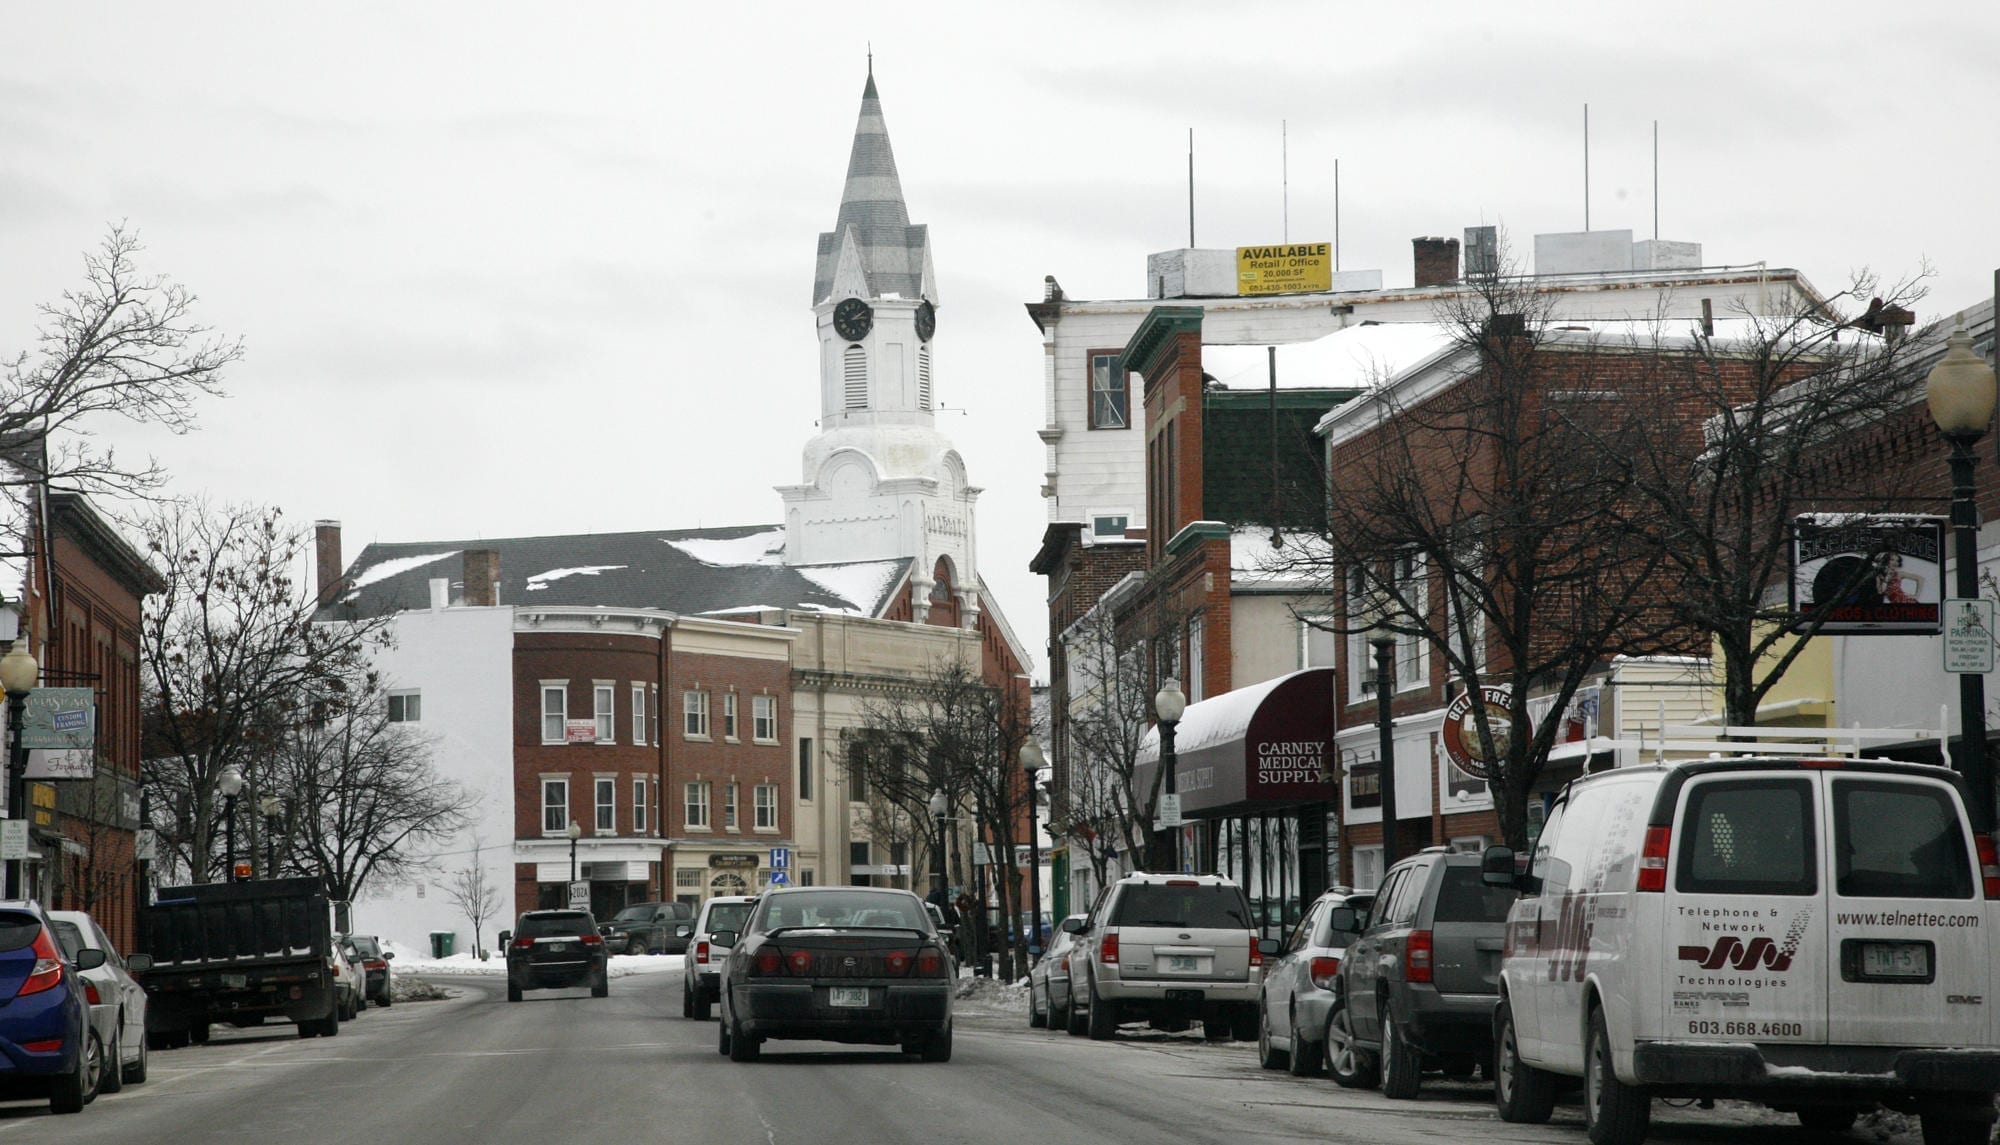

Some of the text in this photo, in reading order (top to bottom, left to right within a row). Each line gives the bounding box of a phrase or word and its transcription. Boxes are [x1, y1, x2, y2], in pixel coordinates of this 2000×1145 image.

[1242, 244, 1326, 259] AVAILABLE
[1250, 260, 1280, 269] Retail
[1289, 259, 1320, 267] Office
[1874, 606, 1937, 620] CLOTHING
[1961, 605, 1978, 614] TWO
[1951, 627, 1986, 638] PARKING
[1484, 690, 1513, 710] FRES
[57, 713, 82, 721] CUSTOM
[56, 721, 85, 729] FRAMING
[1258, 742, 1325, 755] CARNEY
[1258, 770, 1322, 784] SUPPLY
[773, 849, 785, 867] H
[573, 887, 588, 898] 202A
[1678, 907, 1778, 918] Telephone &
[1837, 910, 1979, 927] www.telnettec.com
[1702, 922, 1766, 932] Network
[1678, 976, 1787, 988] Technologies
[1946, 995, 1983, 1004] GMC
[1688, 1020, 1802, 1036] 603.668.4600
